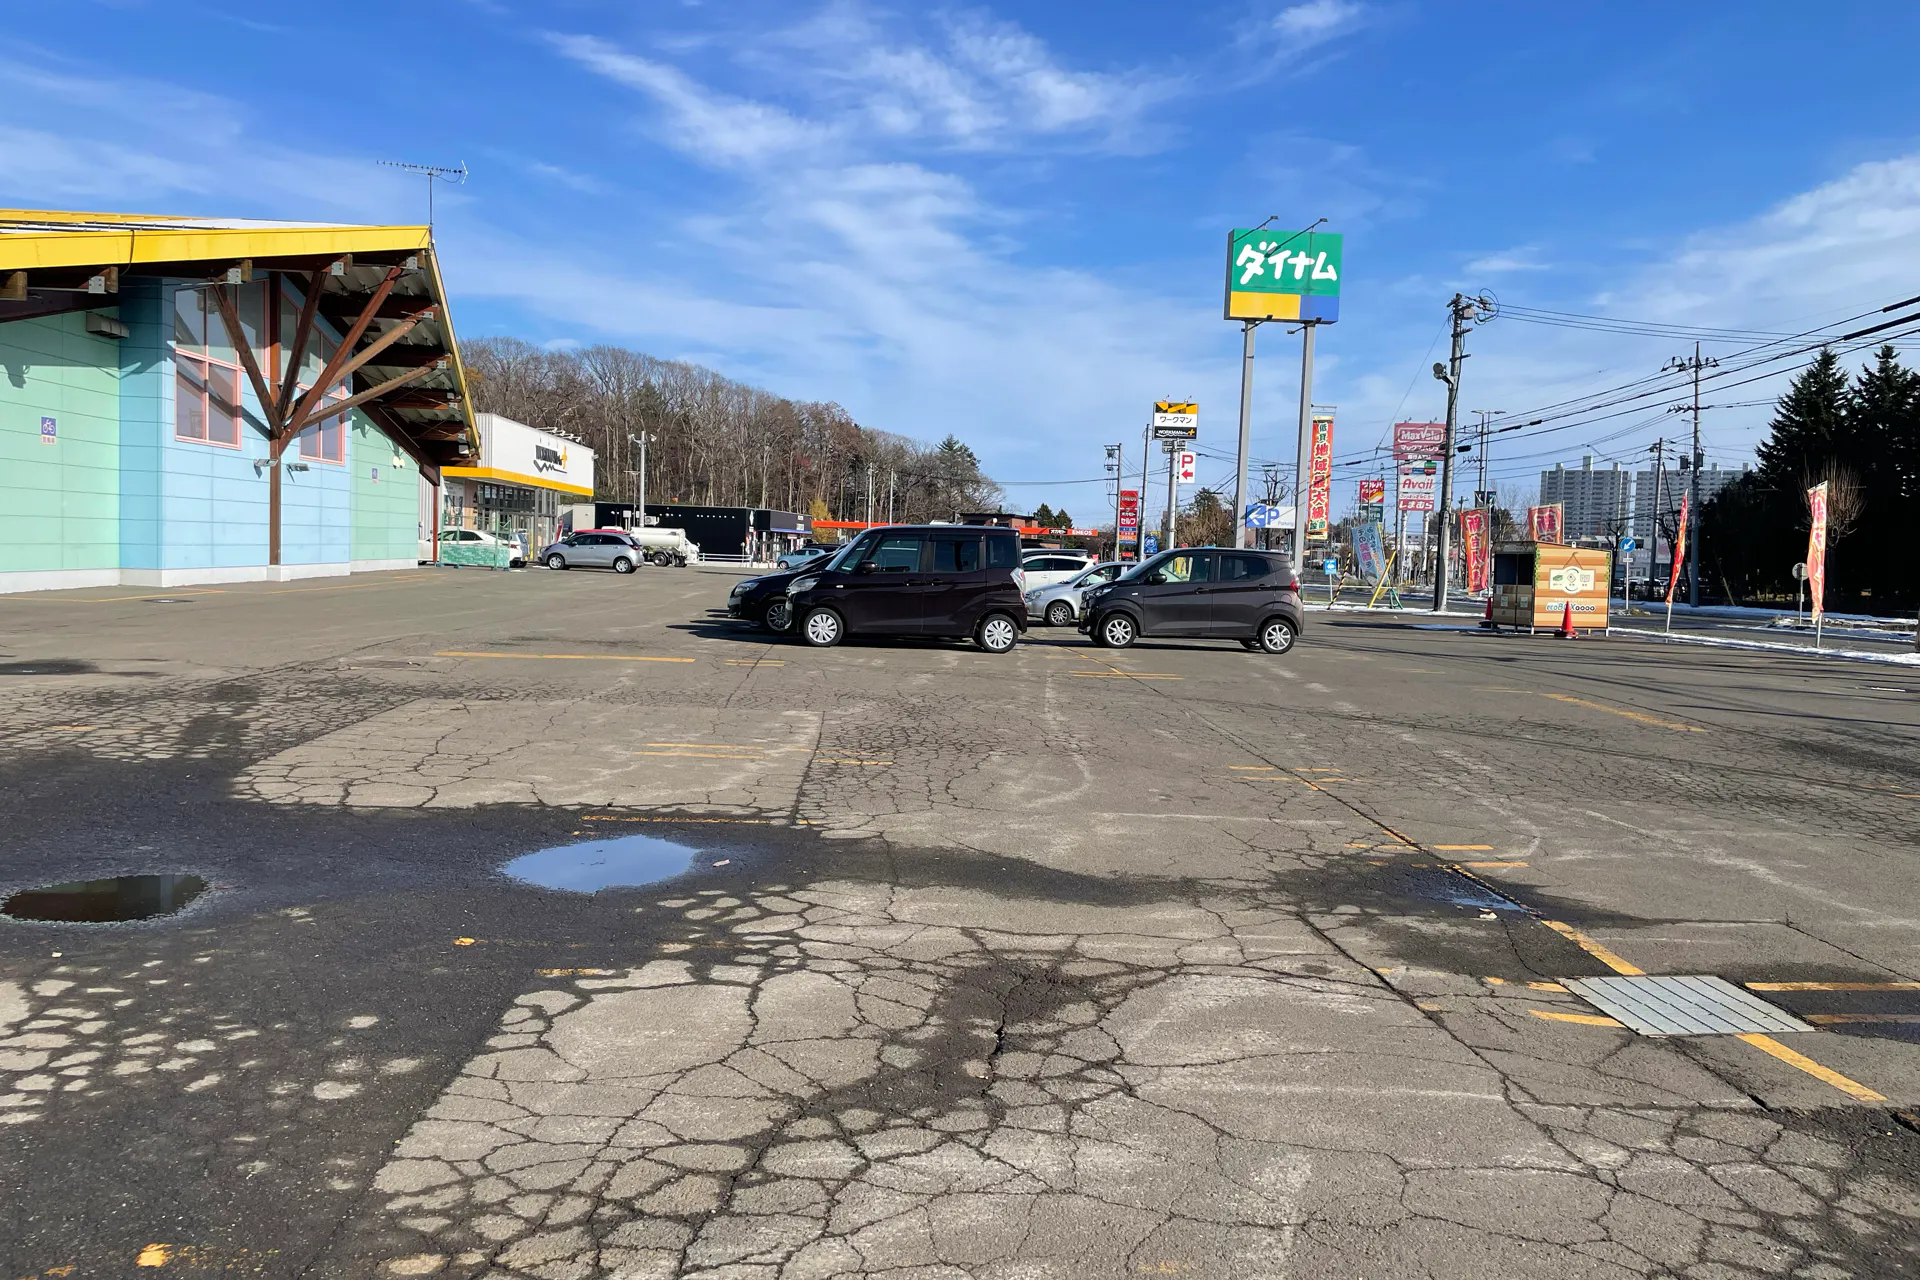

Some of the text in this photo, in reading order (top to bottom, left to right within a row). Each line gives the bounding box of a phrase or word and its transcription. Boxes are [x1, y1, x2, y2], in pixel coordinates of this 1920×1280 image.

[1236, 241, 1338, 285] ダイナム
[1160, 416, 1192, 424] ワークマン
[1401, 427, 1440, 440] MaxValu
[1182, 455, 1193, 468] P
[1402, 478, 1433, 490] Avail
[1399, 500, 1433, 509] しまむら
[1267, 508, 1280, 526] P
